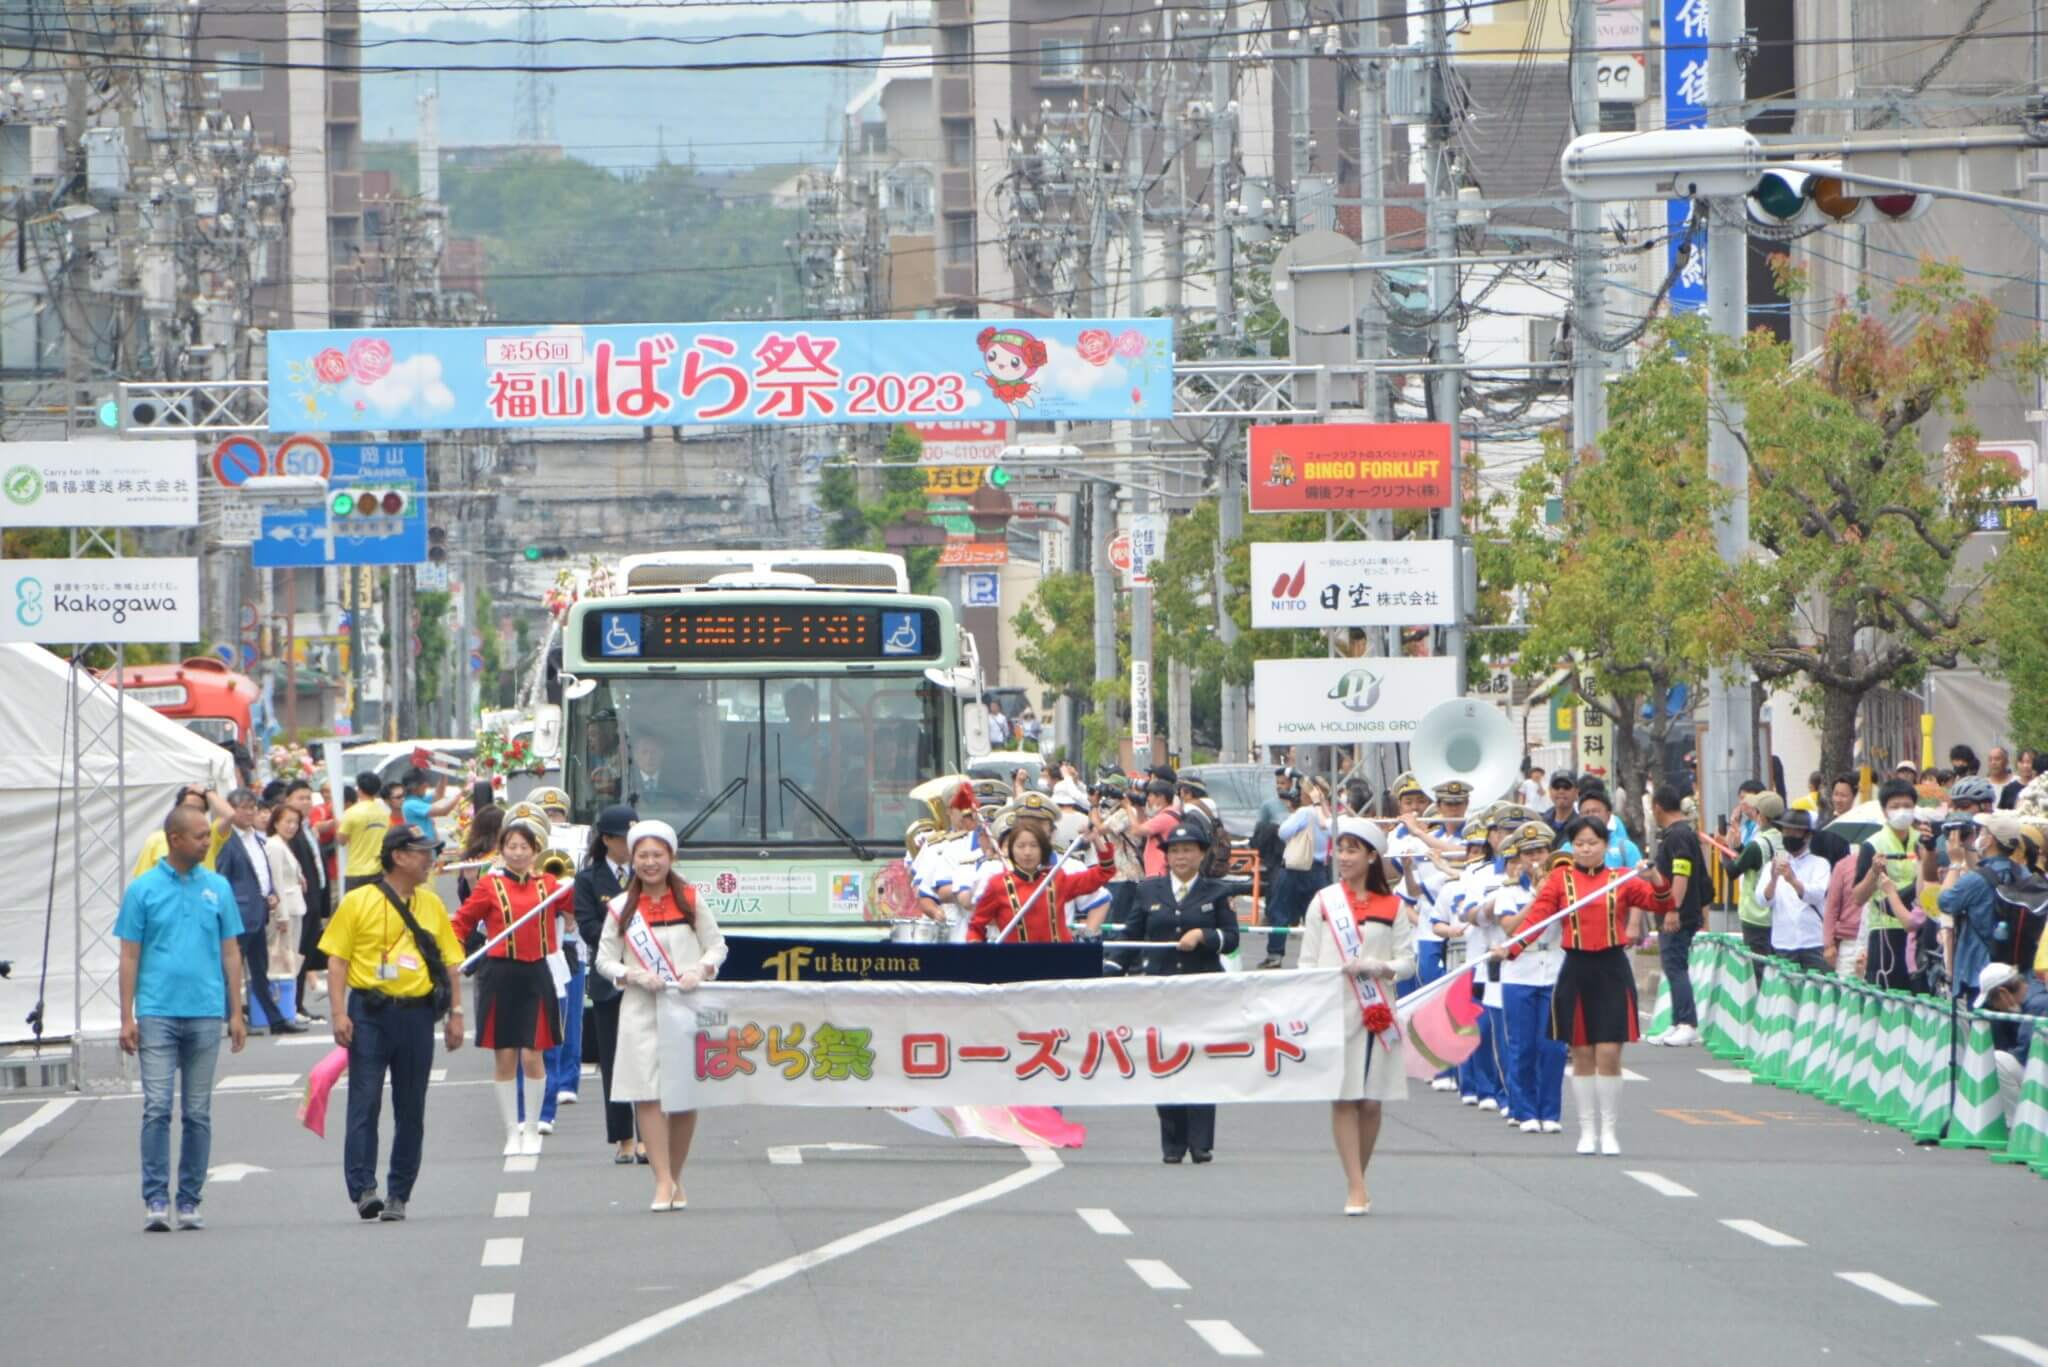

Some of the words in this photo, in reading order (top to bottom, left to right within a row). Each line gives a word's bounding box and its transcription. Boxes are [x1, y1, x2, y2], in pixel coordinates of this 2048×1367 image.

[500, 341, 569, 361] 第56回
[848, 375, 965, 413] 2023
[360, 446, 404, 465] 岡山
[1303, 462, 1356, 480] BINGO
[1360, 460, 1441, 479] FORKLIFT
[54, 594, 178, 625] Kakogawa
[1278, 722, 1316, 733] HOWA
[1320, 720, 1385, 732] HOLDINGS
[901, 1020, 1308, 1080] ローズパレード
